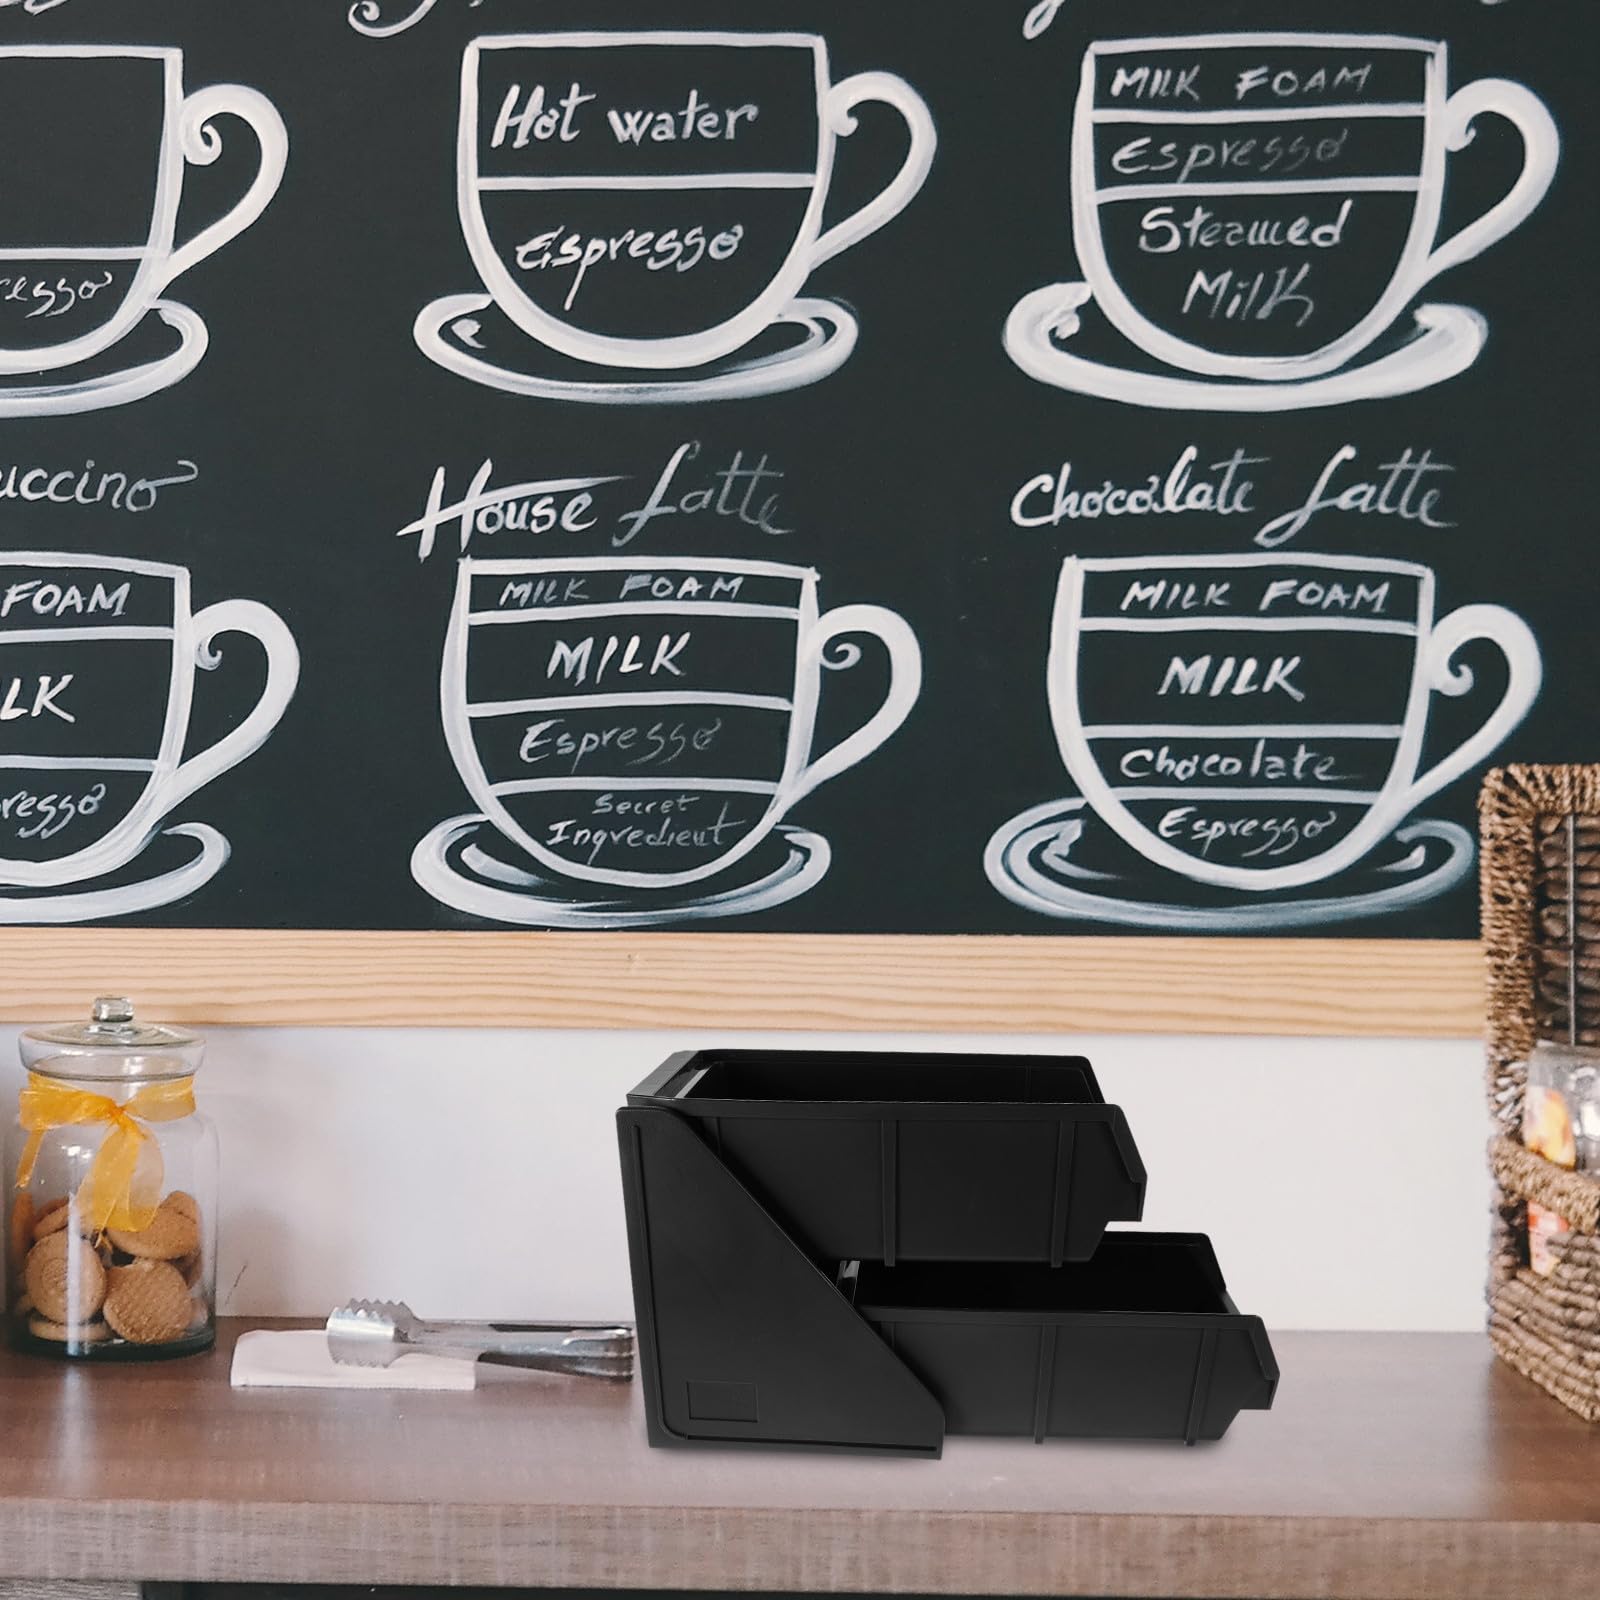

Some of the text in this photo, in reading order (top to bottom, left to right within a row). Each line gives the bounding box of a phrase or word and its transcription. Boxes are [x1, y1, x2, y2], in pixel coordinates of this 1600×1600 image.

[1111, 64, 1371, 100] MILK FOAM
[491, 82, 759, 149] Hot water
[1112, 128, 1348, 183] Espresso
[1139, 198, 1353, 253] Steamed
[516, 224, 744, 311] Espresso
[396, 440, 794, 563] House Latte
[1010, 444, 1459, 548] Chocolate Latte
[0, 580, 130, 617] FOAM
[499, 574, 744, 608] MILK FOAM
[1120, 579, 1390, 613] MILK FOAM
[547, 631, 691, 687] MILK
[1157, 655, 1305, 702] MILK
[519, 717, 722, 775] Espresso
[1119, 738, 1362, 781] Chocolate
[0, 783, 107, 839] resso
[592, 793, 700, 815] Secret
[1158, 806, 1337, 857] Espresso
[546, 801, 746, 866] Ingredient
